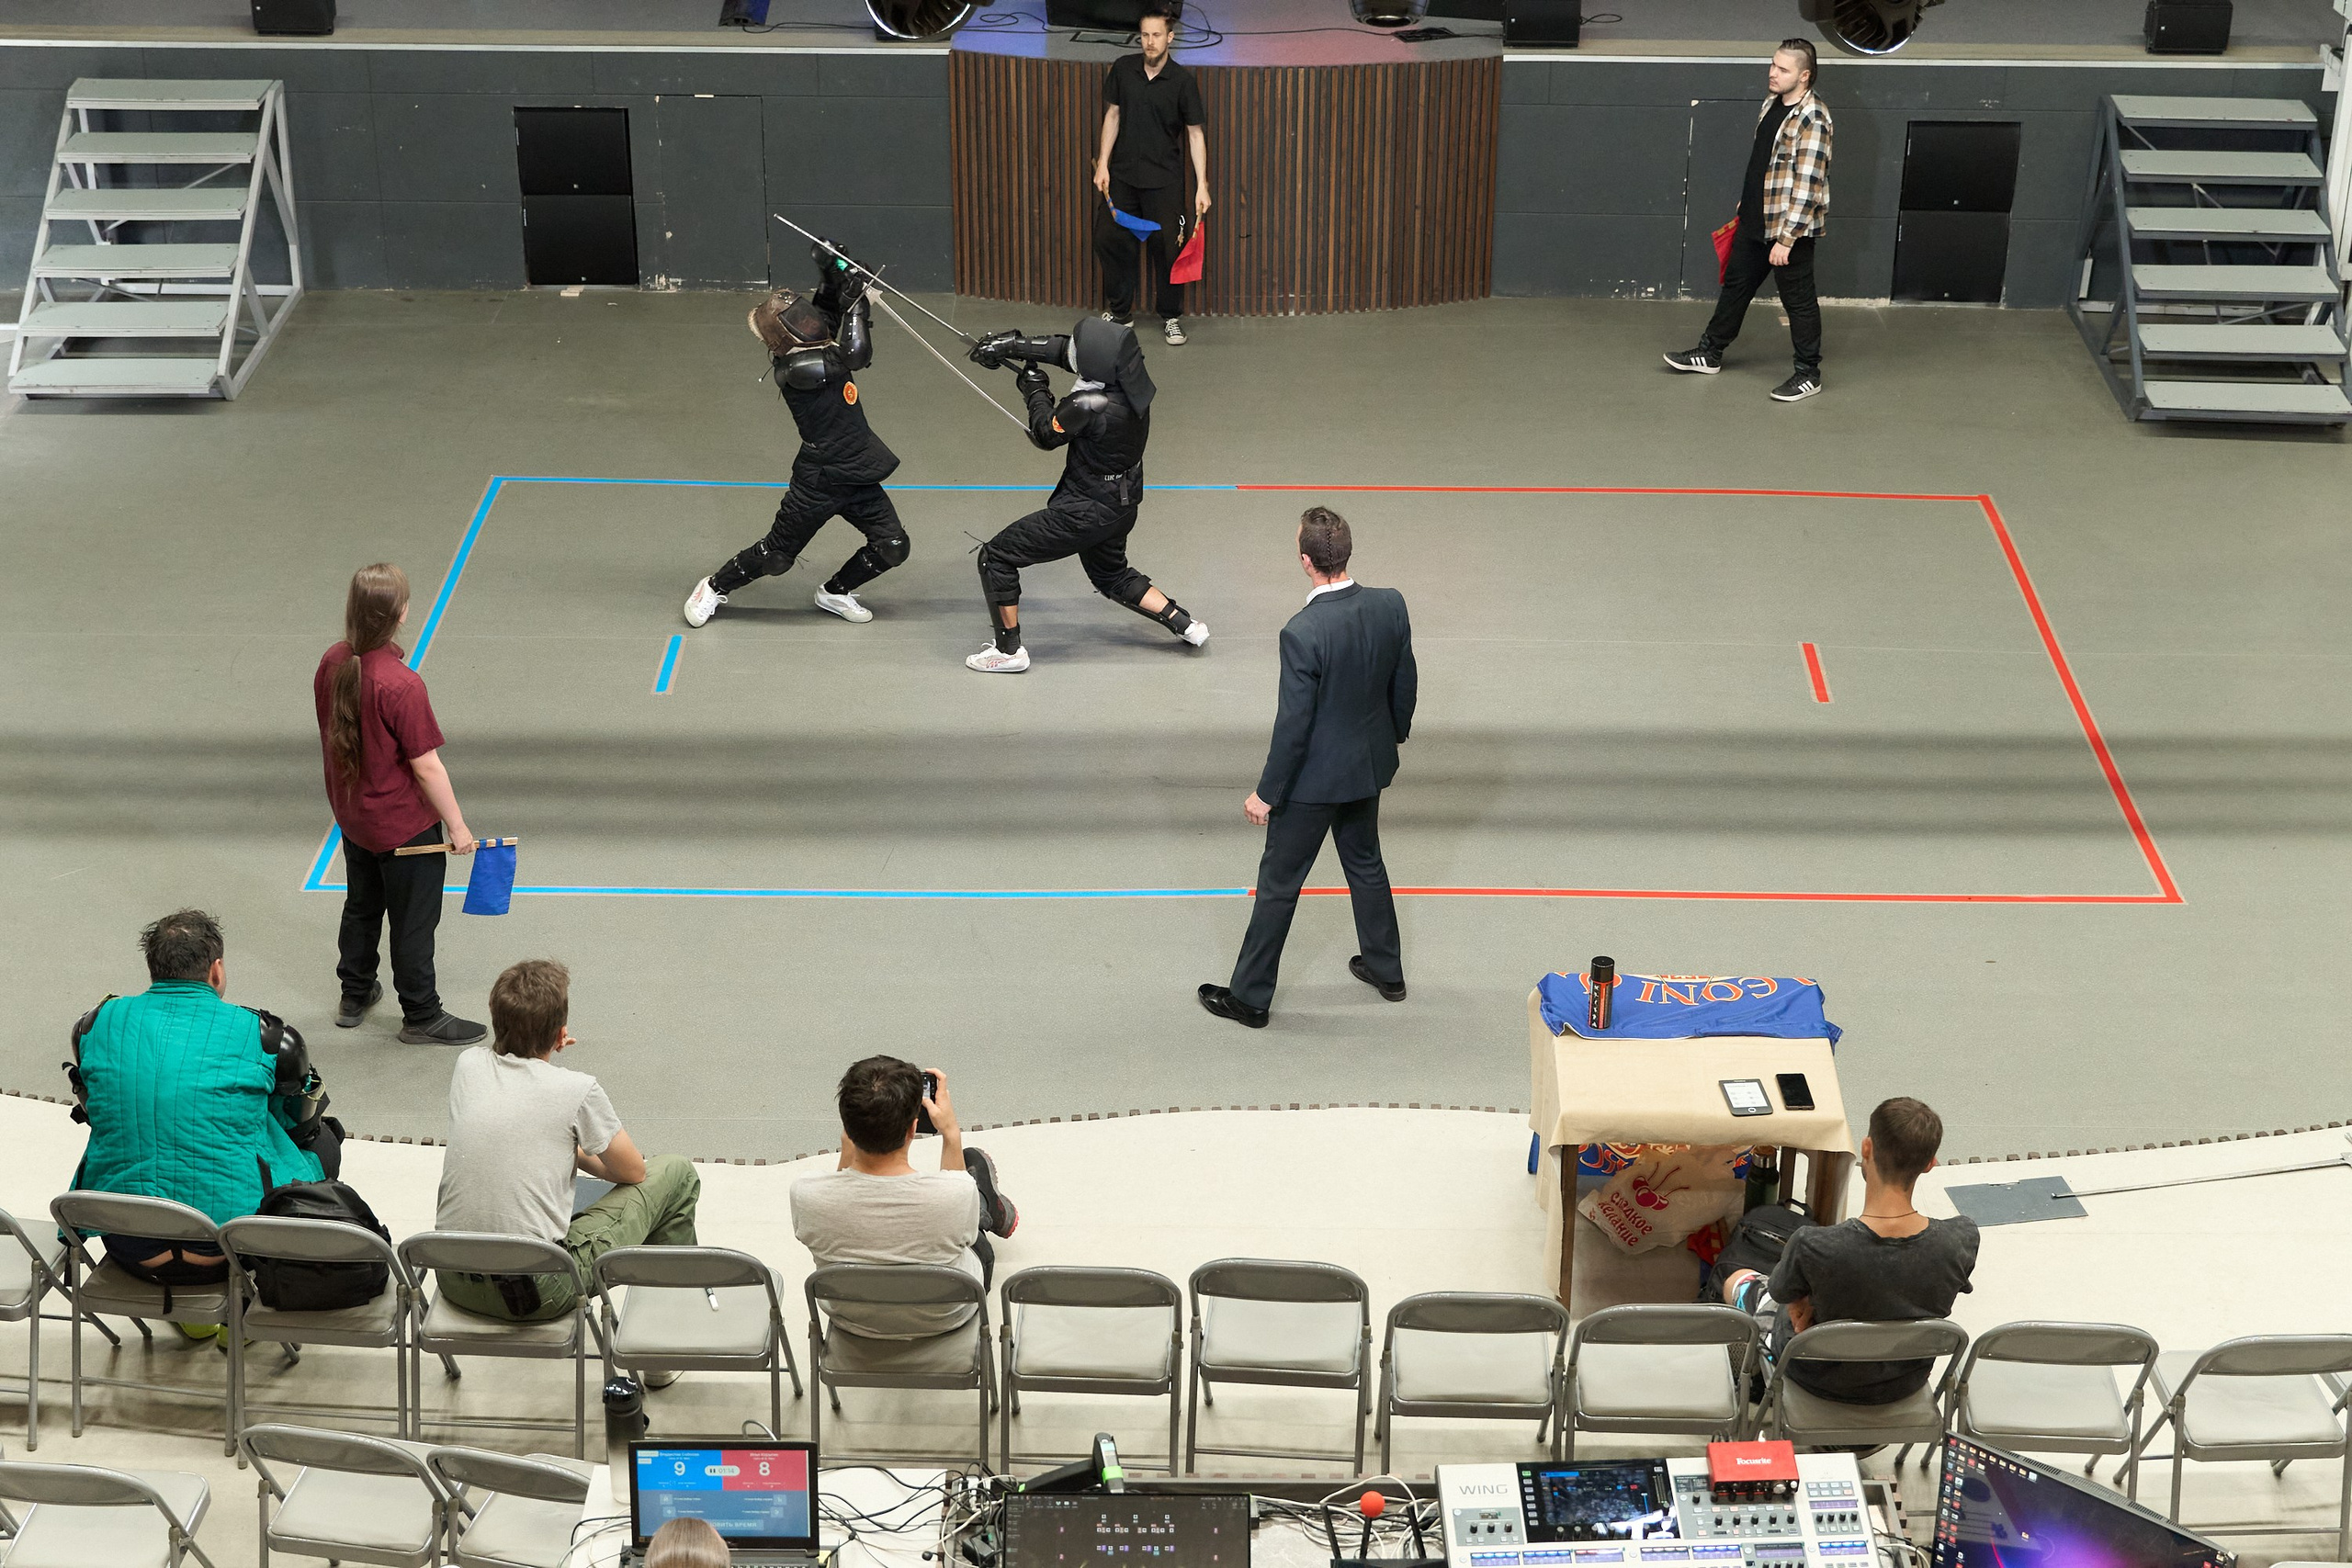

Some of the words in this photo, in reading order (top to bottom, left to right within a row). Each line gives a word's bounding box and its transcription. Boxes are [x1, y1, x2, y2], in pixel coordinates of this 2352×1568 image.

[673, 1461, 685, 1476] 9
[759, 1461, 771, 1476] 8
[1459, 1483, 1509, 1495] WING
